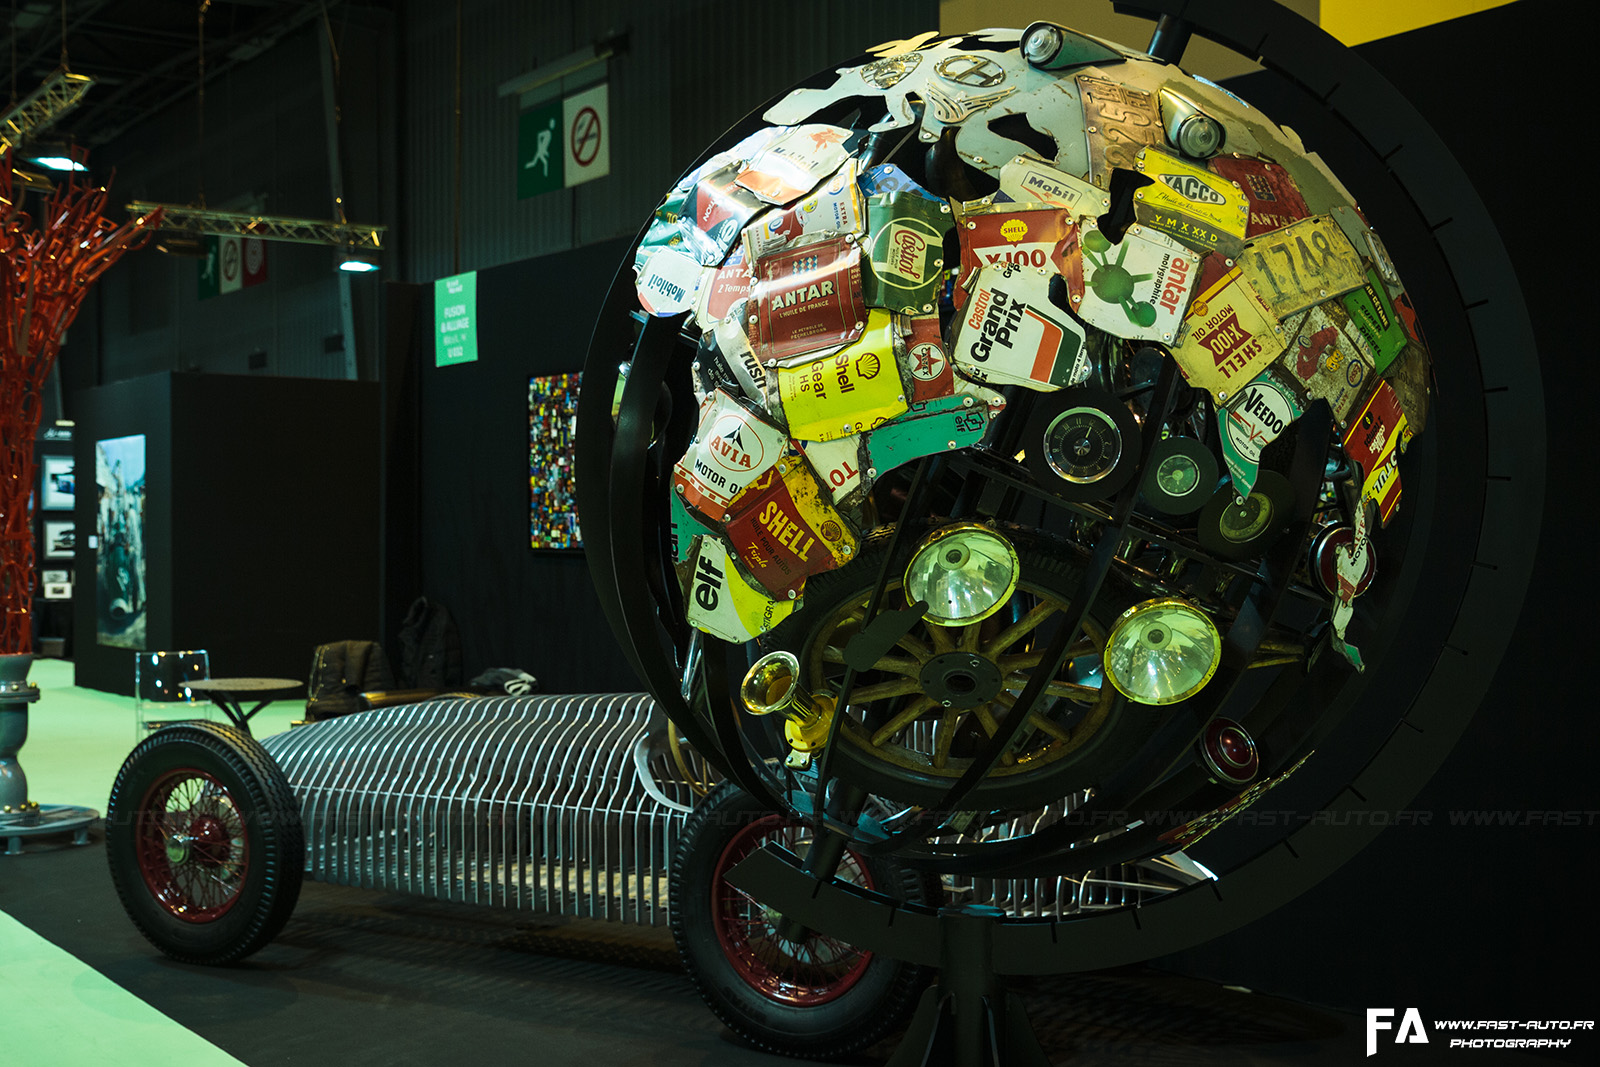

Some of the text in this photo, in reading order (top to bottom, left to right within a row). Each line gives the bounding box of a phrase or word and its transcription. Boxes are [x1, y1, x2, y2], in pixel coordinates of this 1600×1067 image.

[1029, 176, 1076, 202] Mobil
[1165, 176, 1219, 202] YACCO
[840, 202, 848, 225] EXTRA
[1003, 226, 1026, 235] SHELL
[1167, 218, 1177, 227] M
[1181, 222, 1189, 232] X
[1192, 227, 1207, 238] XX
[1210, 234, 1218, 242] D
[895, 230, 926, 280] Castrol
[648, 274, 686, 303] Mobiloil
[718, 284, 750, 295] 2 Temps
[1150, 254, 1170, 305] molygraphite
[1160, 257, 1190, 315] antar
[772, 281, 835, 312] ANTAR
[780, 309, 798, 319] L'HUILE
[808, 300, 829, 310] FRANCE
[968, 289, 992, 330] Castrol
[970, 288, 1009, 363] Grand
[995, 298, 1027, 350] Prix
[1205, 304, 1234, 331] MOTOR
[1360, 305, 1382, 332] SUPER
[1192, 327, 1207, 342] OIL
[1210, 322, 1244, 356] X-100
[1218, 338, 1263, 379] SHELL
[800, 375, 810, 393] HS
[812, 361, 828, 400] Gear
[836, 355, 855, 394] Shell
[955, 416, 966, 432] elf
[1243, 388, 1287, 434] VEEDO
[710, 436, 752, 469] AVIA
[1236, 437, 1250, 450] MOTOR
[695, 459, 727, 488] MOTOR
[751, 517, 791, 576] HUILE POUR AUTOS
[759, 501, 816, 562] SHELL
[746, 542, 767, 569] Triple
[695, 555, 724, 612] elf
